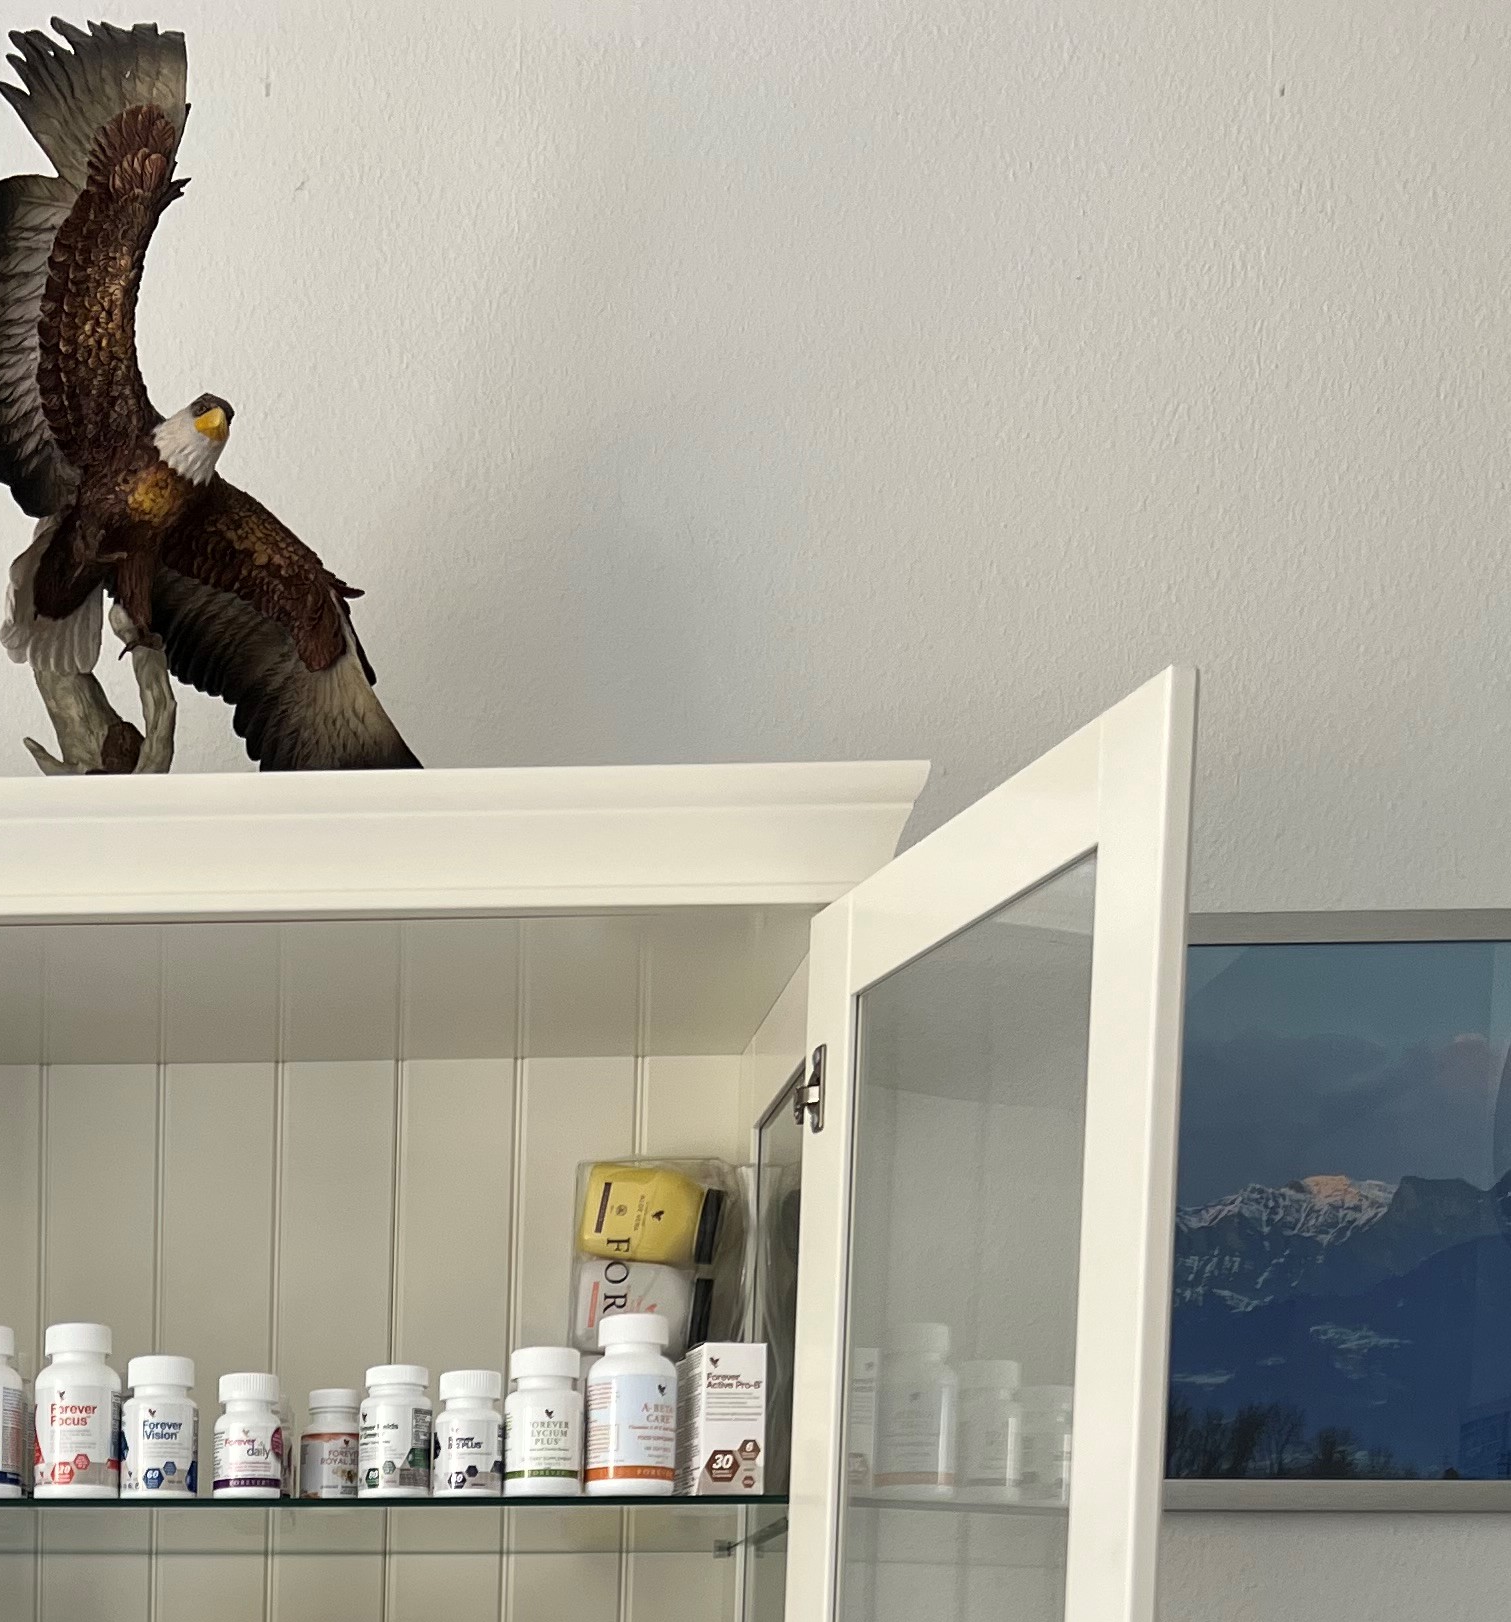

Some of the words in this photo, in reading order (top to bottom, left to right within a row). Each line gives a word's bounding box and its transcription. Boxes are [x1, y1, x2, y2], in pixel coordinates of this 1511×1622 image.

[707, 1373, 741, 1381] Forever
[706, 1381, 734, 1389] Active
[143, 1420, 183, 1431] Forever
[143, 1430, 178, 1440] Vision
[531, 1430, 568, 1438] LYCIUM
[534, 1438, 560, 1446] PLUS
[246, 1441, 271, 1460] daily
[712, 1454, 734, 1469] 30
